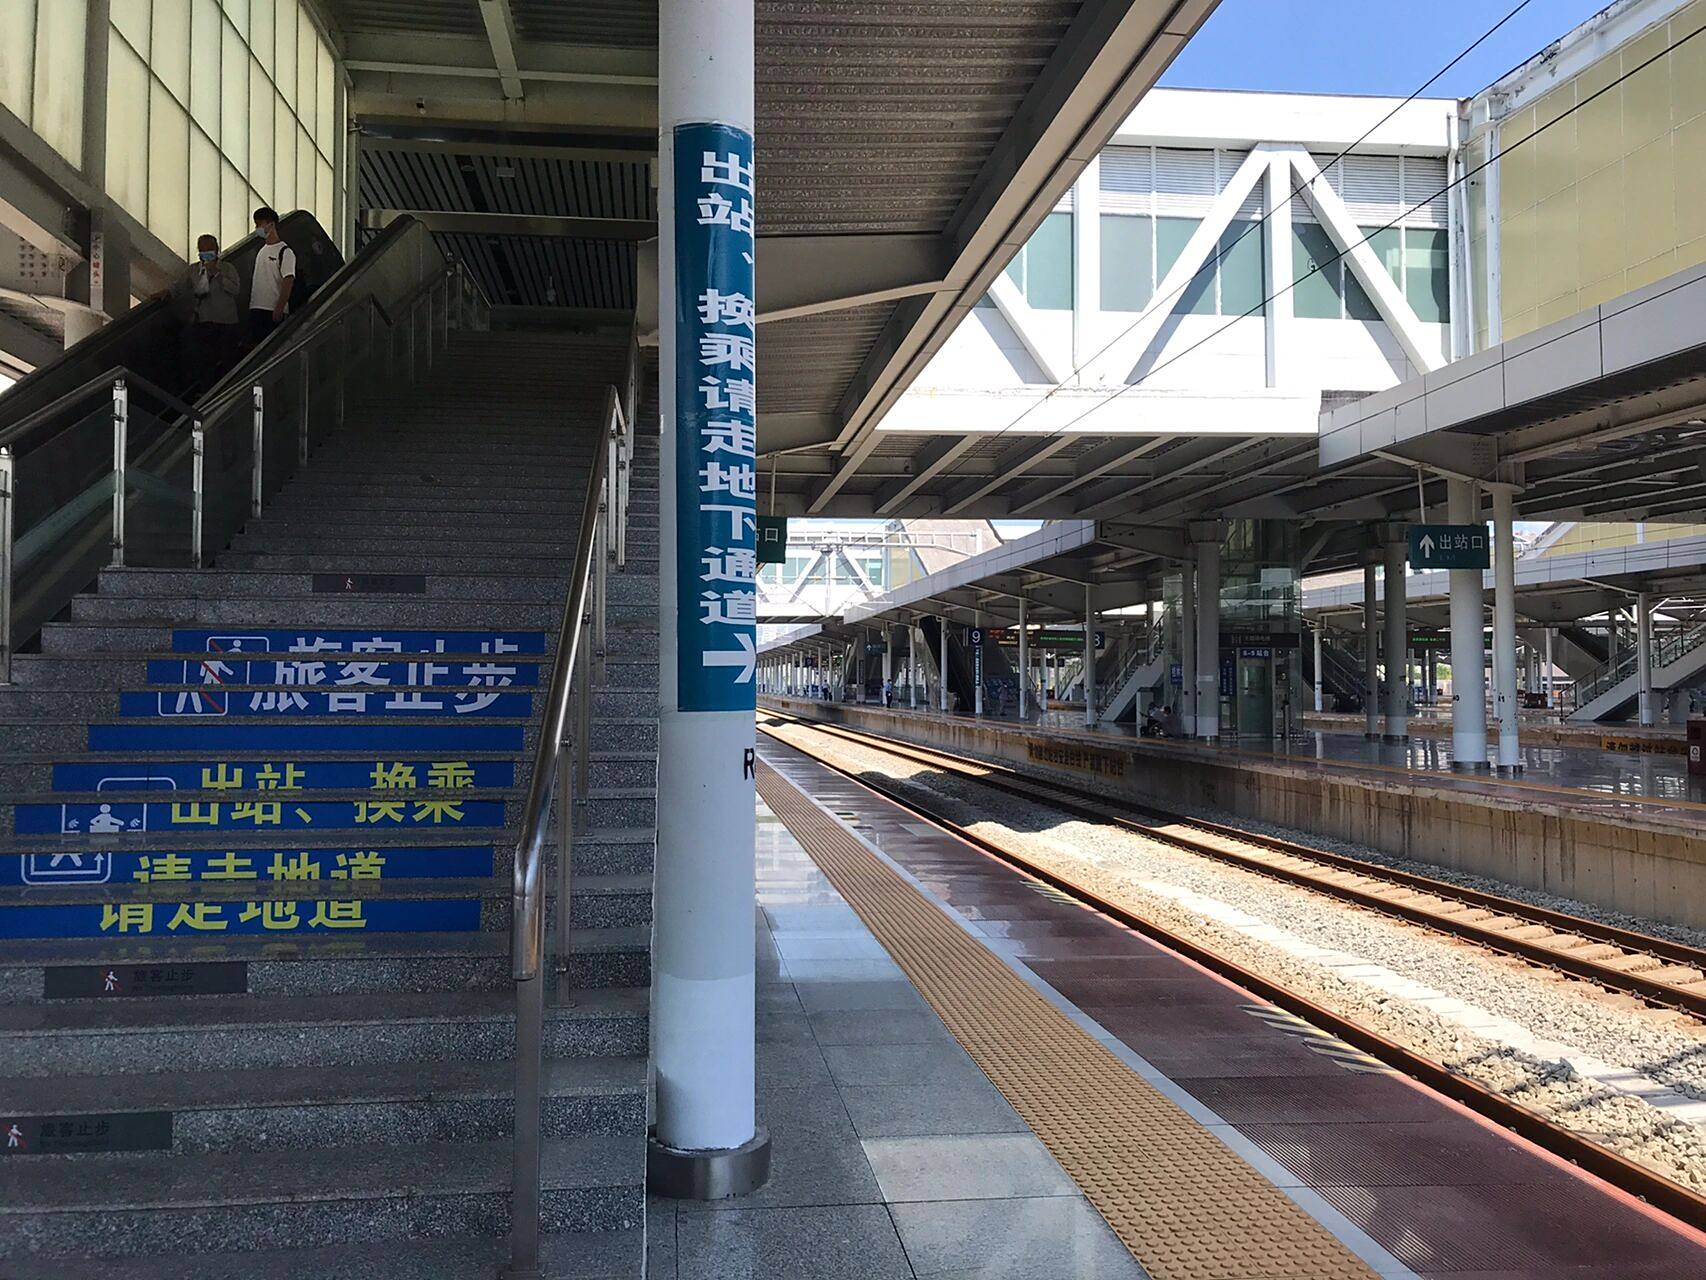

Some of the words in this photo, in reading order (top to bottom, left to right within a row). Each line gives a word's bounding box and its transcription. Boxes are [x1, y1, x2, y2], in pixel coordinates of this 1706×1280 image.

[1439, 534, 1484, 550] 出站口
[972, 630, 981, 643] 9
[249, 637, 519, 714] 旅客止步
